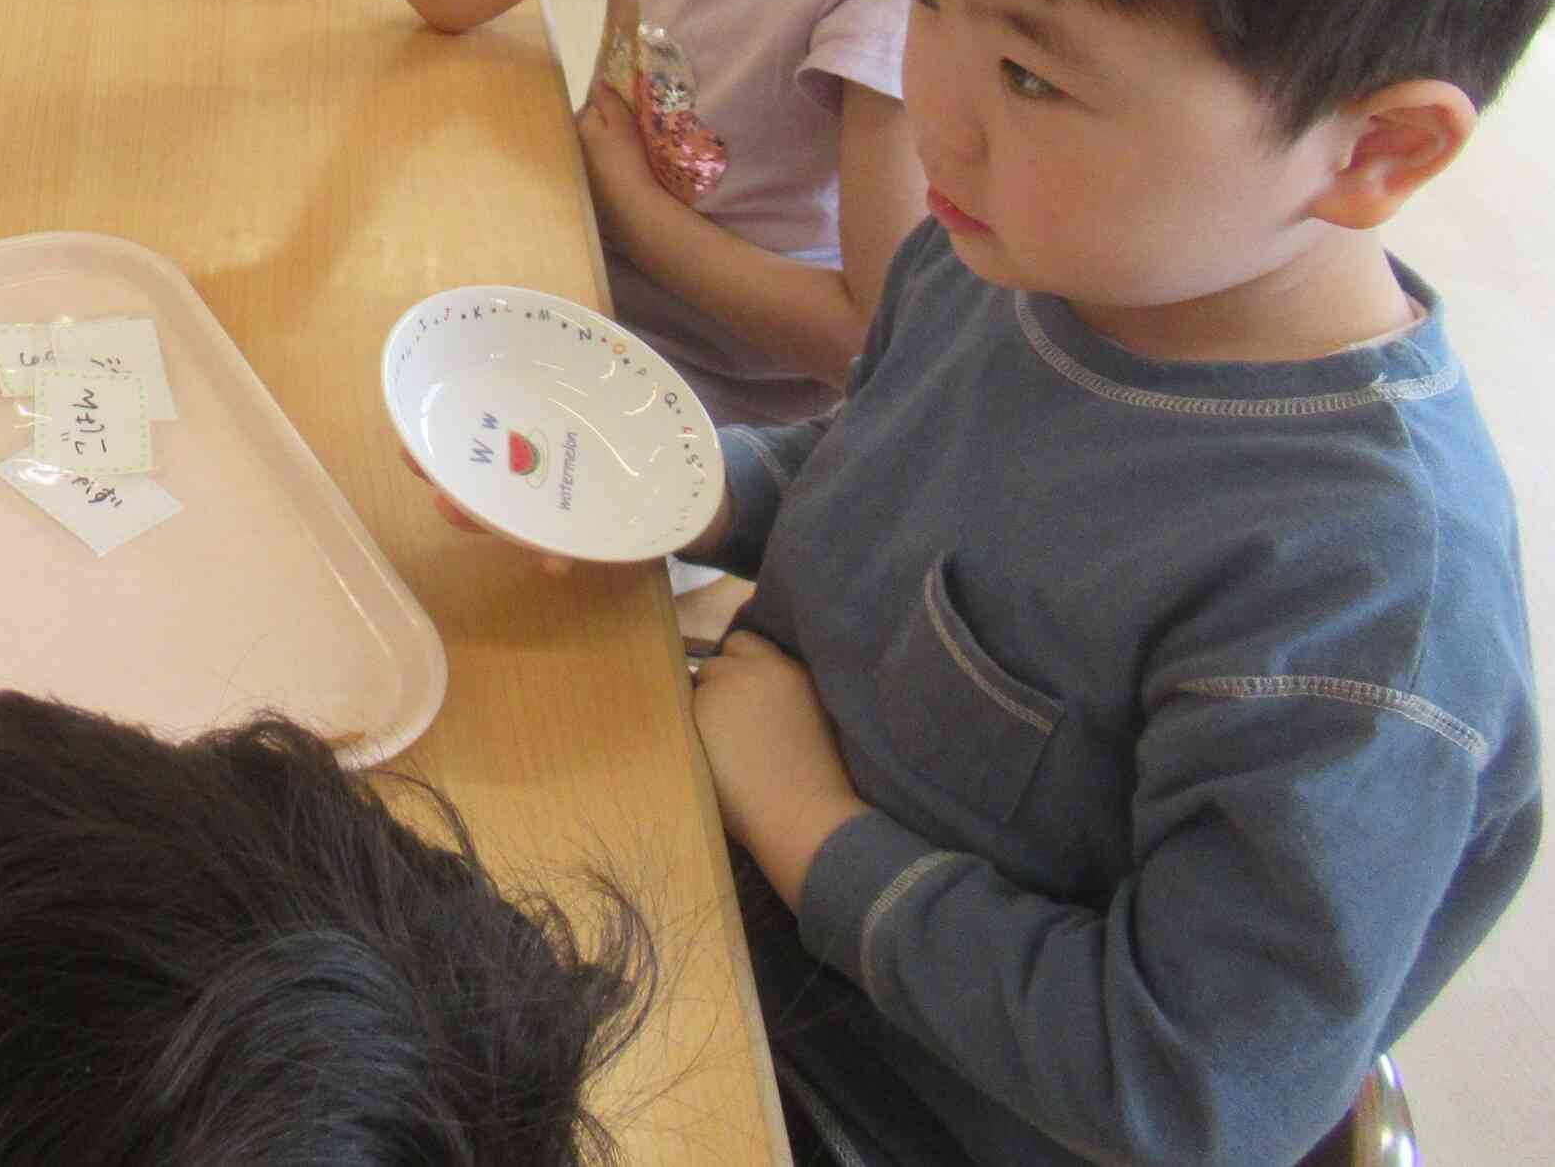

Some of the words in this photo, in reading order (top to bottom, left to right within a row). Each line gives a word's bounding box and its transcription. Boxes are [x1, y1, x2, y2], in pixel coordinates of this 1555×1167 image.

[60, 388, 109, 455] ごはん
[557, 431, 580, 512] watermelon
